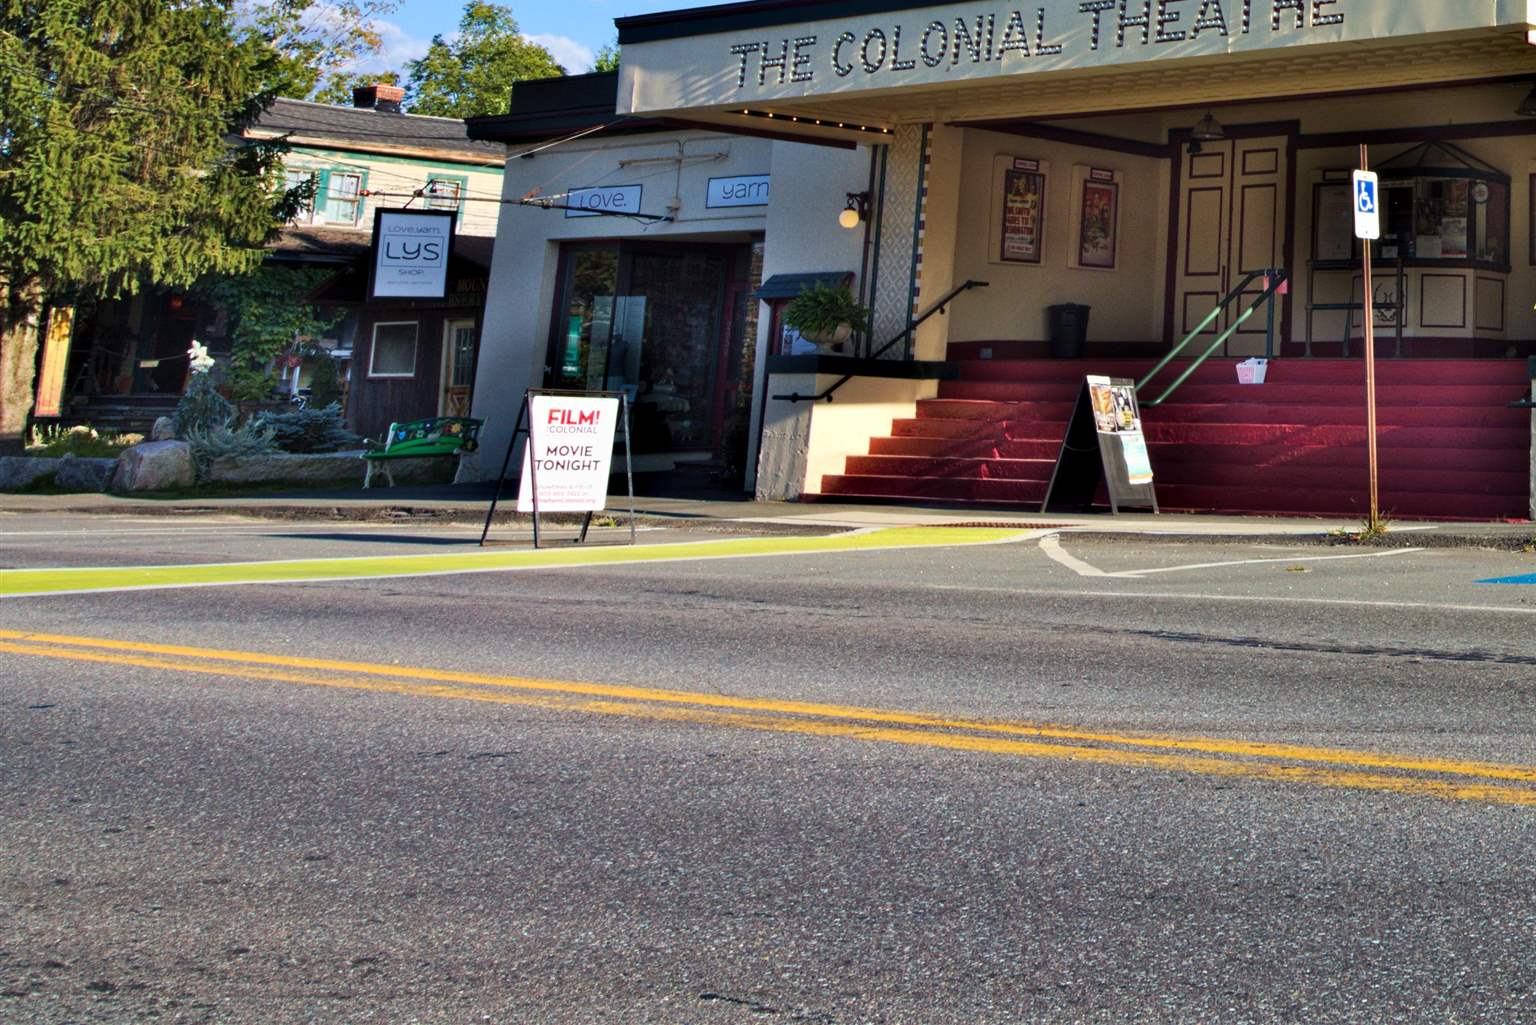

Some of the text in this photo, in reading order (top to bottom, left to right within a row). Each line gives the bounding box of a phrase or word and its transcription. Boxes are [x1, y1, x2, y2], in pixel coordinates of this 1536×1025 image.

[729, 35, 817, 88] THE
[831, 6, 1063, 78] COLONIAL
[399, 268, 424, 276] SHOP
[547, 408, 601, 425] FILM!
[546, 445, 593, 457] MOVIE
[535, 459, 601, 471] TONIGHT
